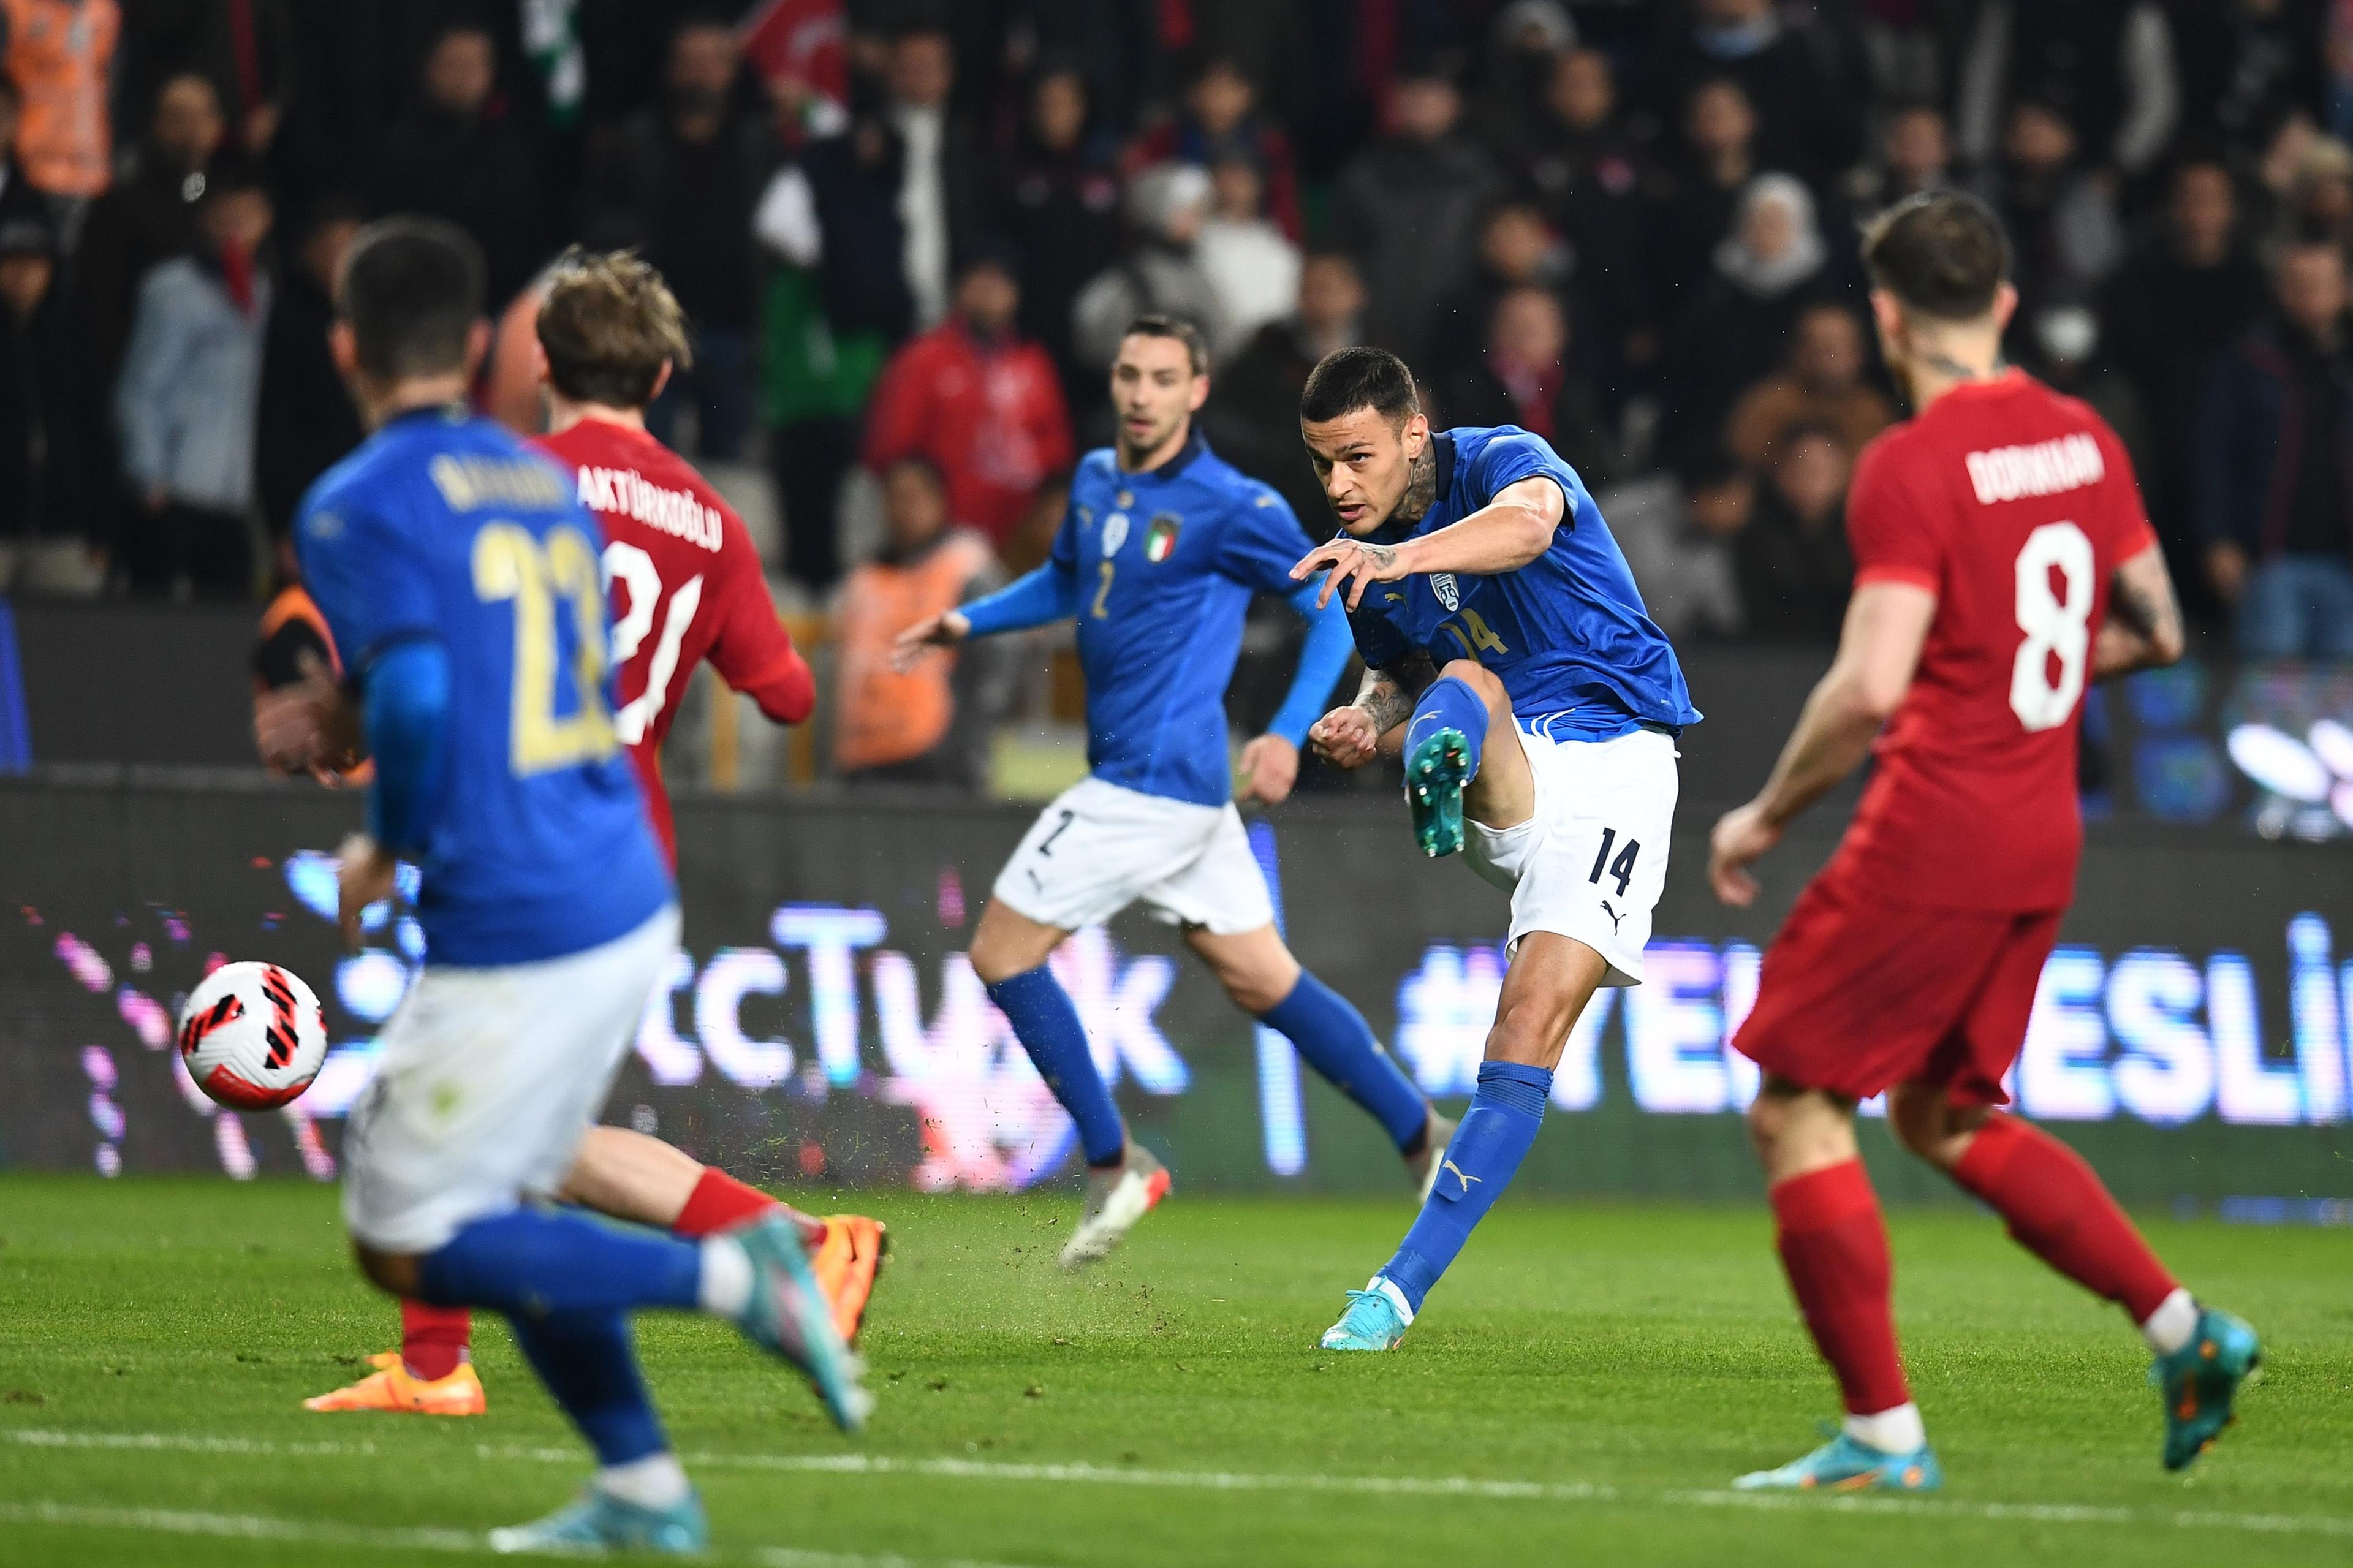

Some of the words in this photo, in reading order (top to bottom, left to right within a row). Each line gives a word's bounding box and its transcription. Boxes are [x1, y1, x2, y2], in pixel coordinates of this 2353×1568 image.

[577, 464, 723, 553] AKTÜRKOĞLU
[1091, 560, 1116, 619] 2
[1438, 607, 1509, 665] 14
[2008, 519, 2096, 733] 8
[1039, 809, 1074, 856] 2
[1588, 827, 1640, 898] 14
